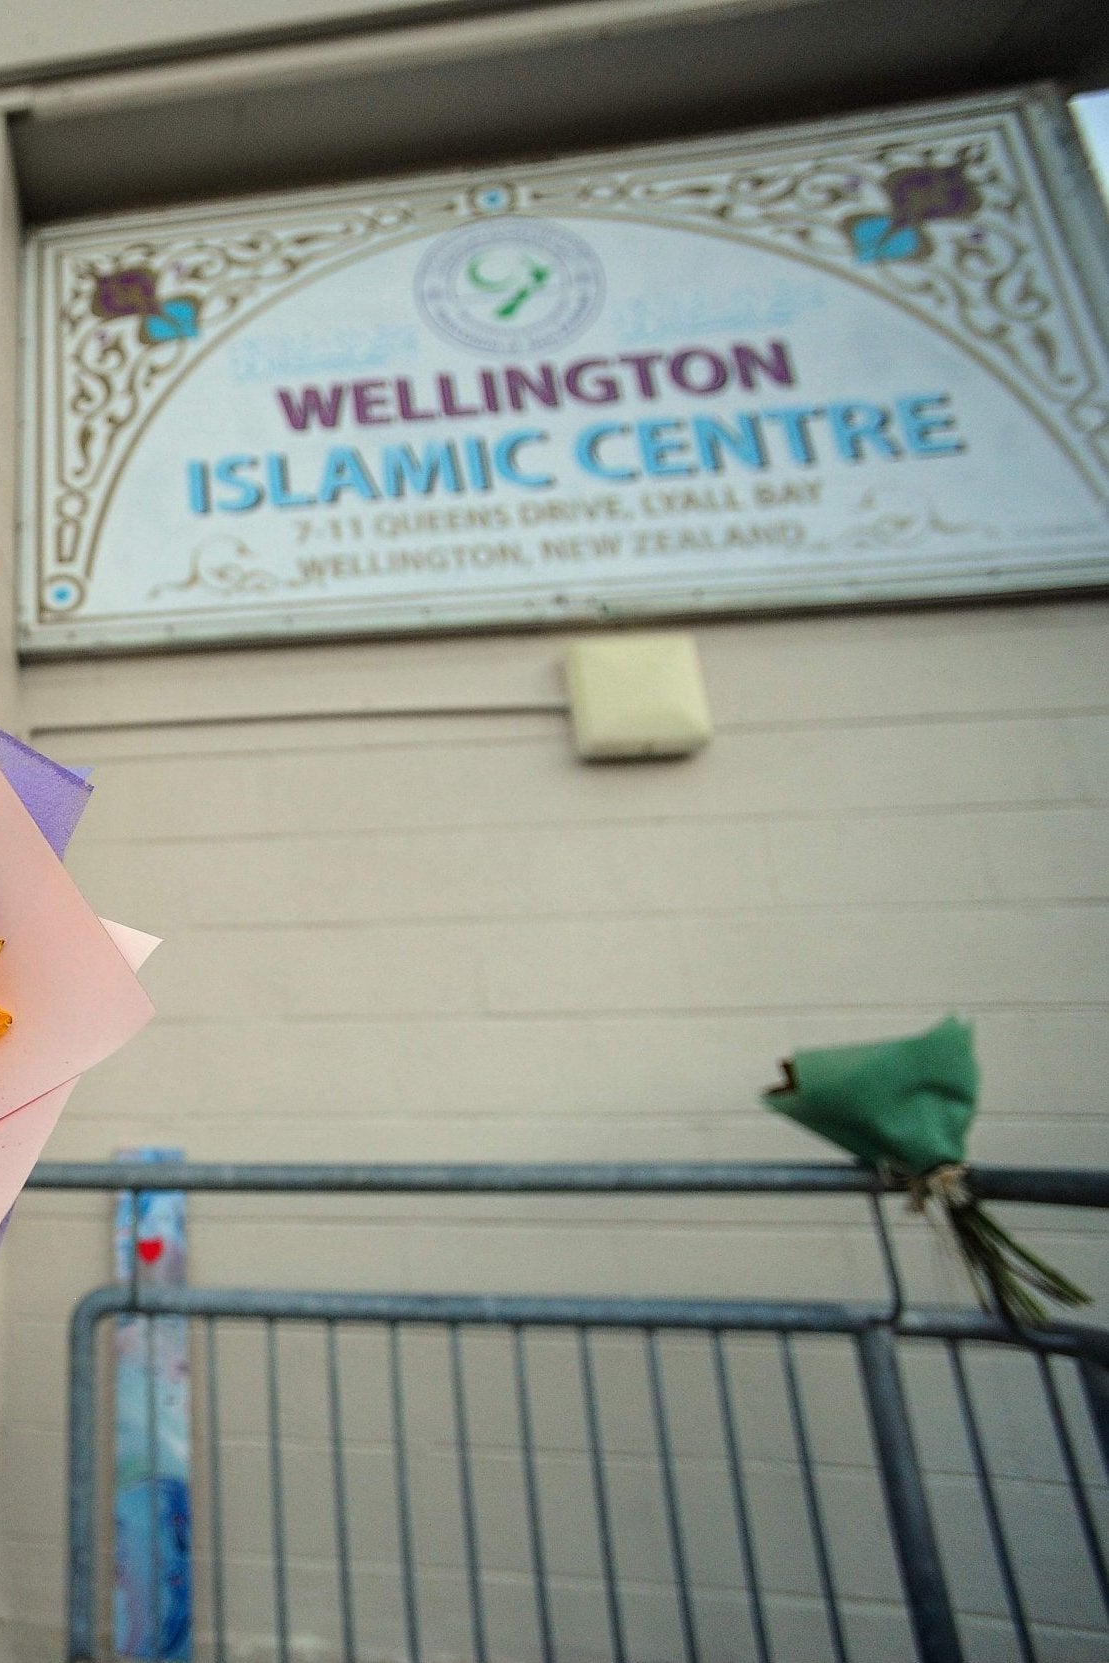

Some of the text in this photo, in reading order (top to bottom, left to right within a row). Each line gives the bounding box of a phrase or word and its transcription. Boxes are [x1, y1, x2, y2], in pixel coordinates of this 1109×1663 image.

[277, 340, 796, 430] WELLINGTON
[186, 392, 968, 516] ISLAMIC CENTRE
[373, 505, 509, 538] QUEENS
[642, 484, 739, 516] LYALL
[752, 480, 823, 507] BAY
[540, 534, 622, 562] NEW
[634, 521, 808, 556] ZEALAND
